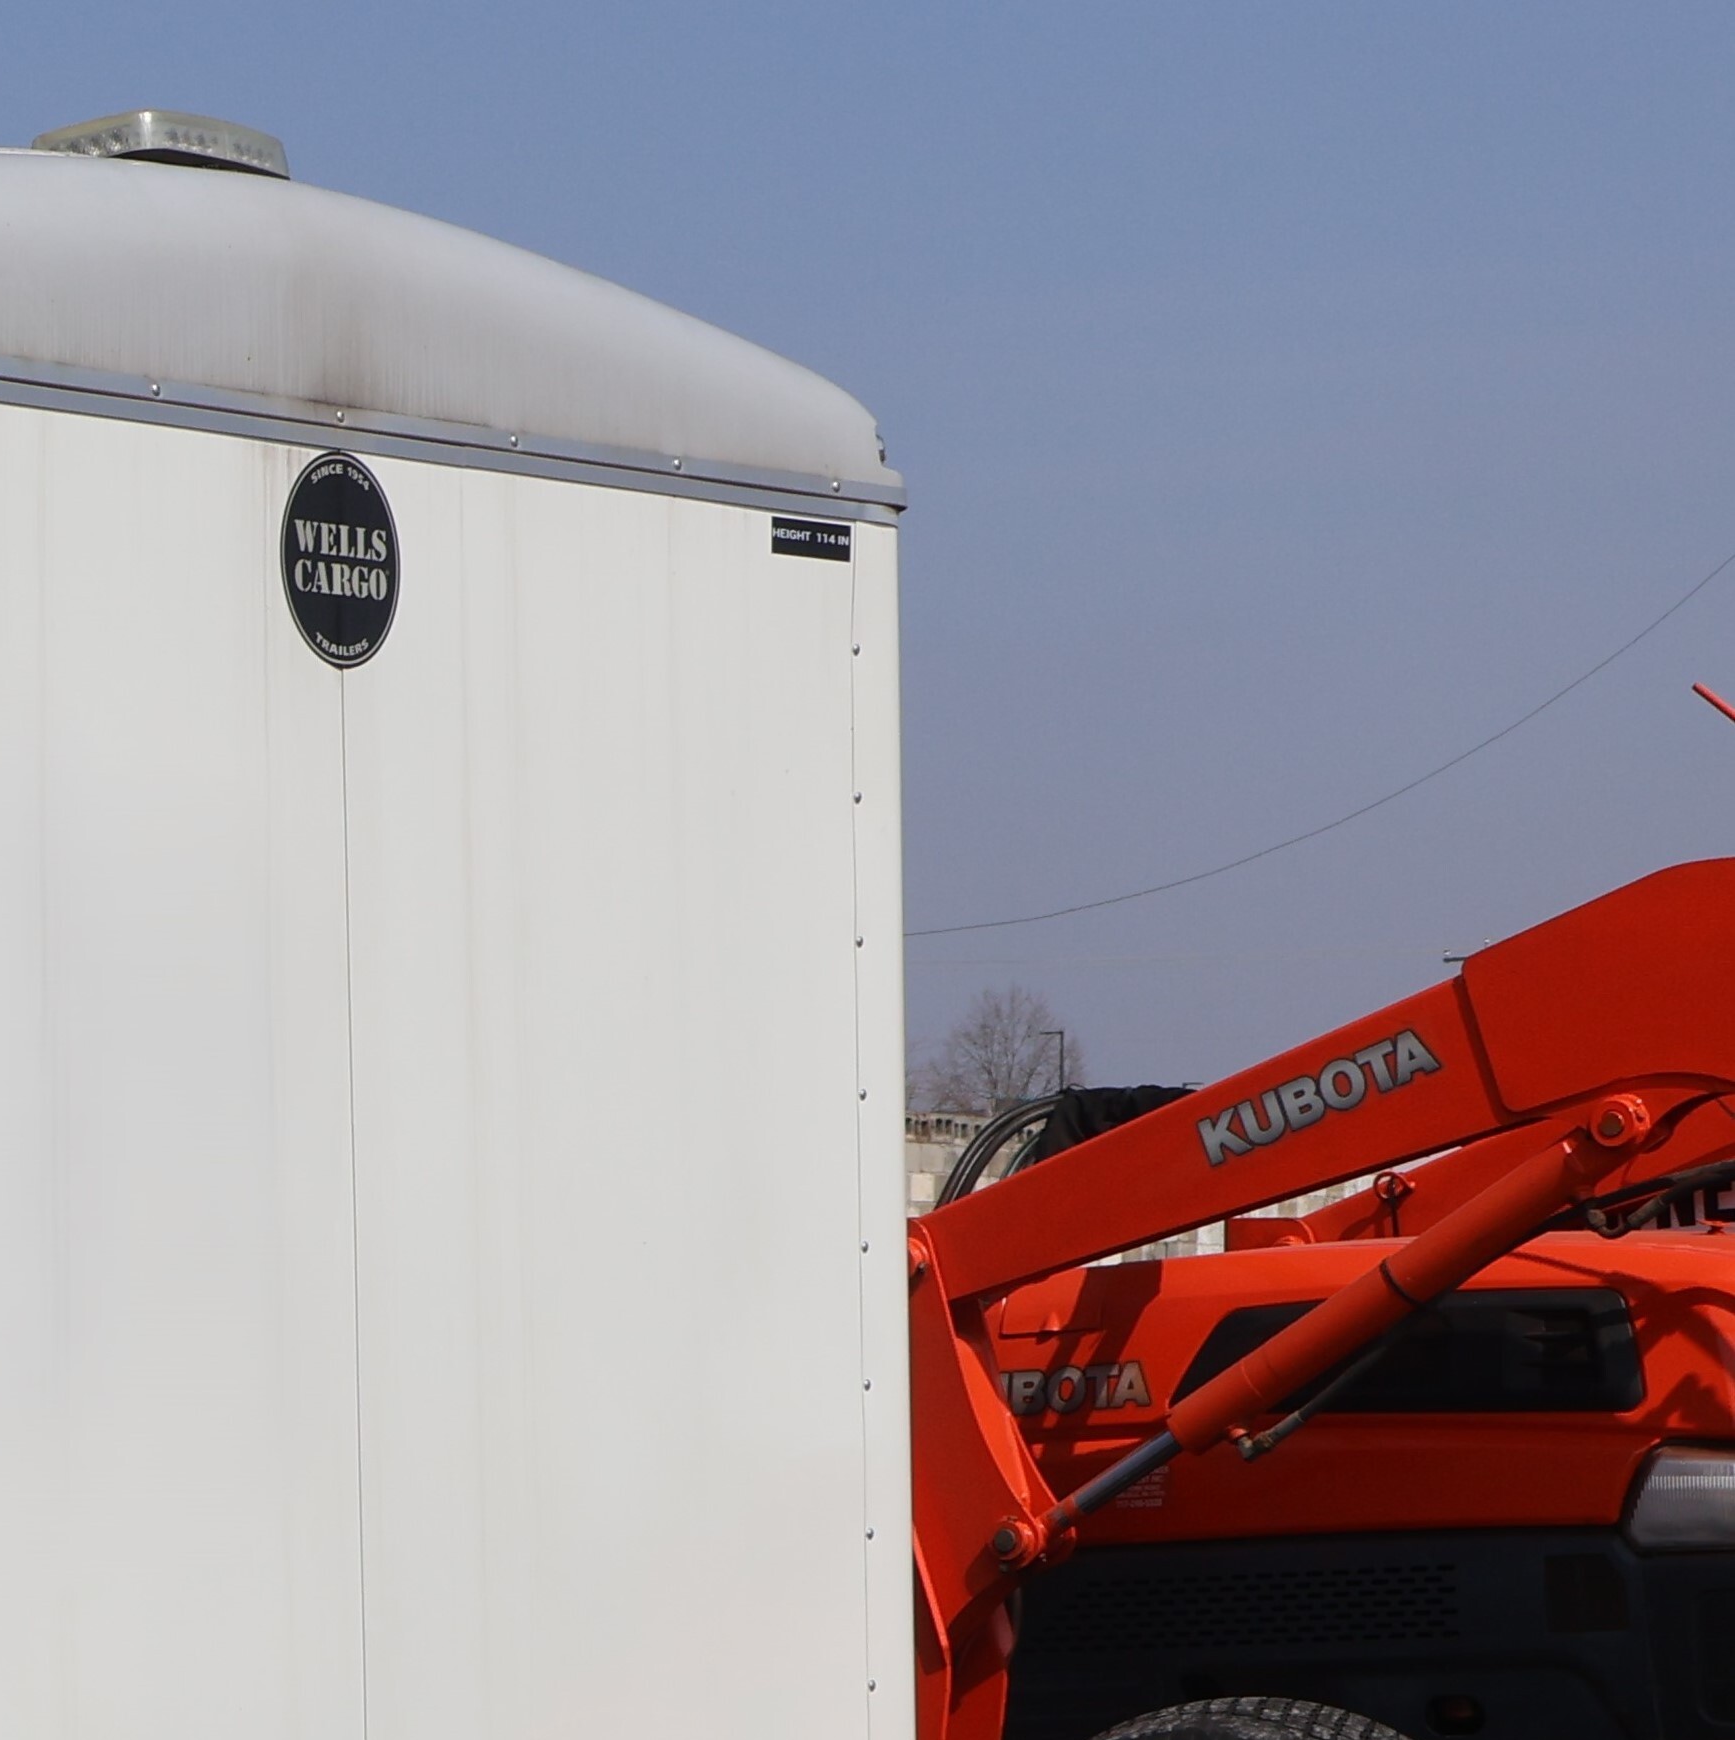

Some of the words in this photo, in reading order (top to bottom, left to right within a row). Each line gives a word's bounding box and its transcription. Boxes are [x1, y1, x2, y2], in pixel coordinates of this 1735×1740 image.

[310, 463, 344, 485] SINCE
[346, 466, 371, 491] 1954
[294, 519, 387, 562] WELLS
[772, 527, 812, 542] HEIGHT
[816, 532, 836, 545] 114
[837, 535, 850, 547] IN
[294, 558, 388, 601] CARGO
[315, 632, 370, 656] TRAILERS
[1196, 1028, 1442, 1167] KUBOTA
[999, 1360, 1151, 1416] BOTA
